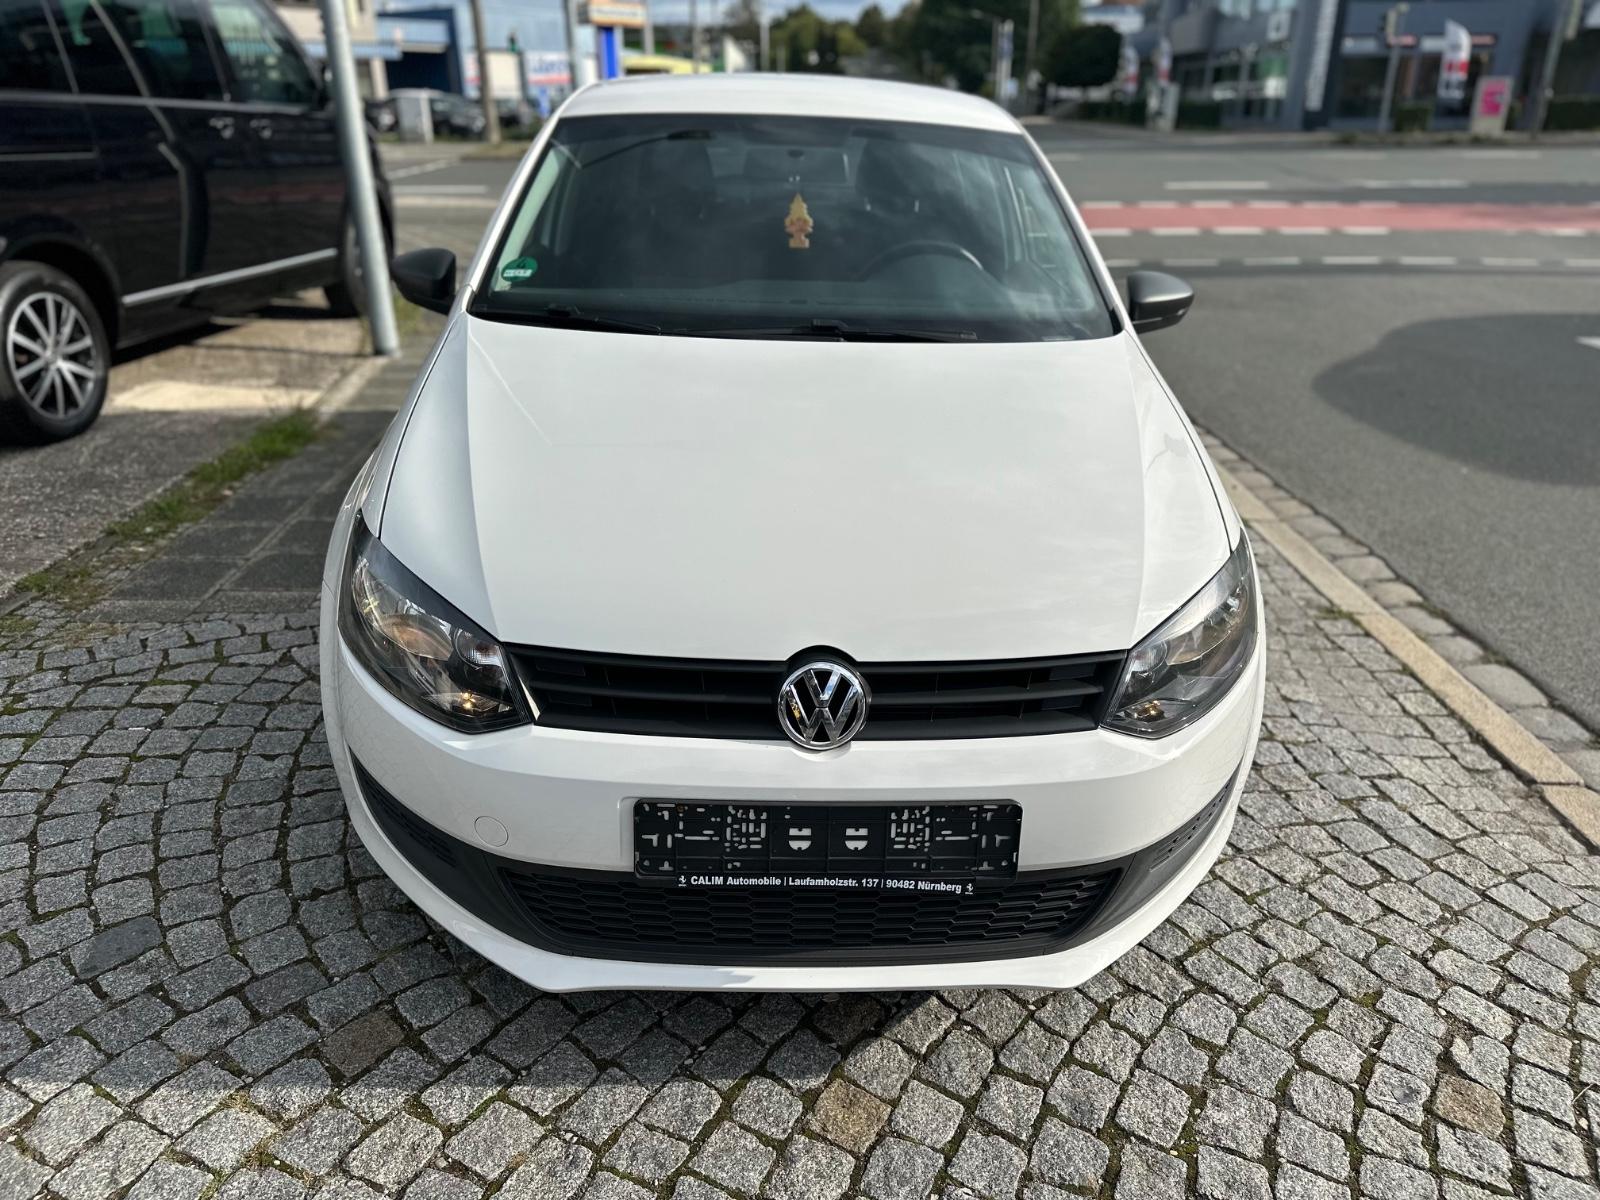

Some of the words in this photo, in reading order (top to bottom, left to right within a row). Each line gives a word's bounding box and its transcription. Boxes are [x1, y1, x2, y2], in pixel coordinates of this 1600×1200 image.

[779, 662, 865, 750] VW
[690, 875, 724, 885] CALIM
[726, 876, 782, 886] Automobile
[788, 877, 859, 887] Laufamholzstr.
[861, 878, 879, 888] 137
[886, 880, 915, 889] 90482
[917, 881, 962, 894] Nürnberg
